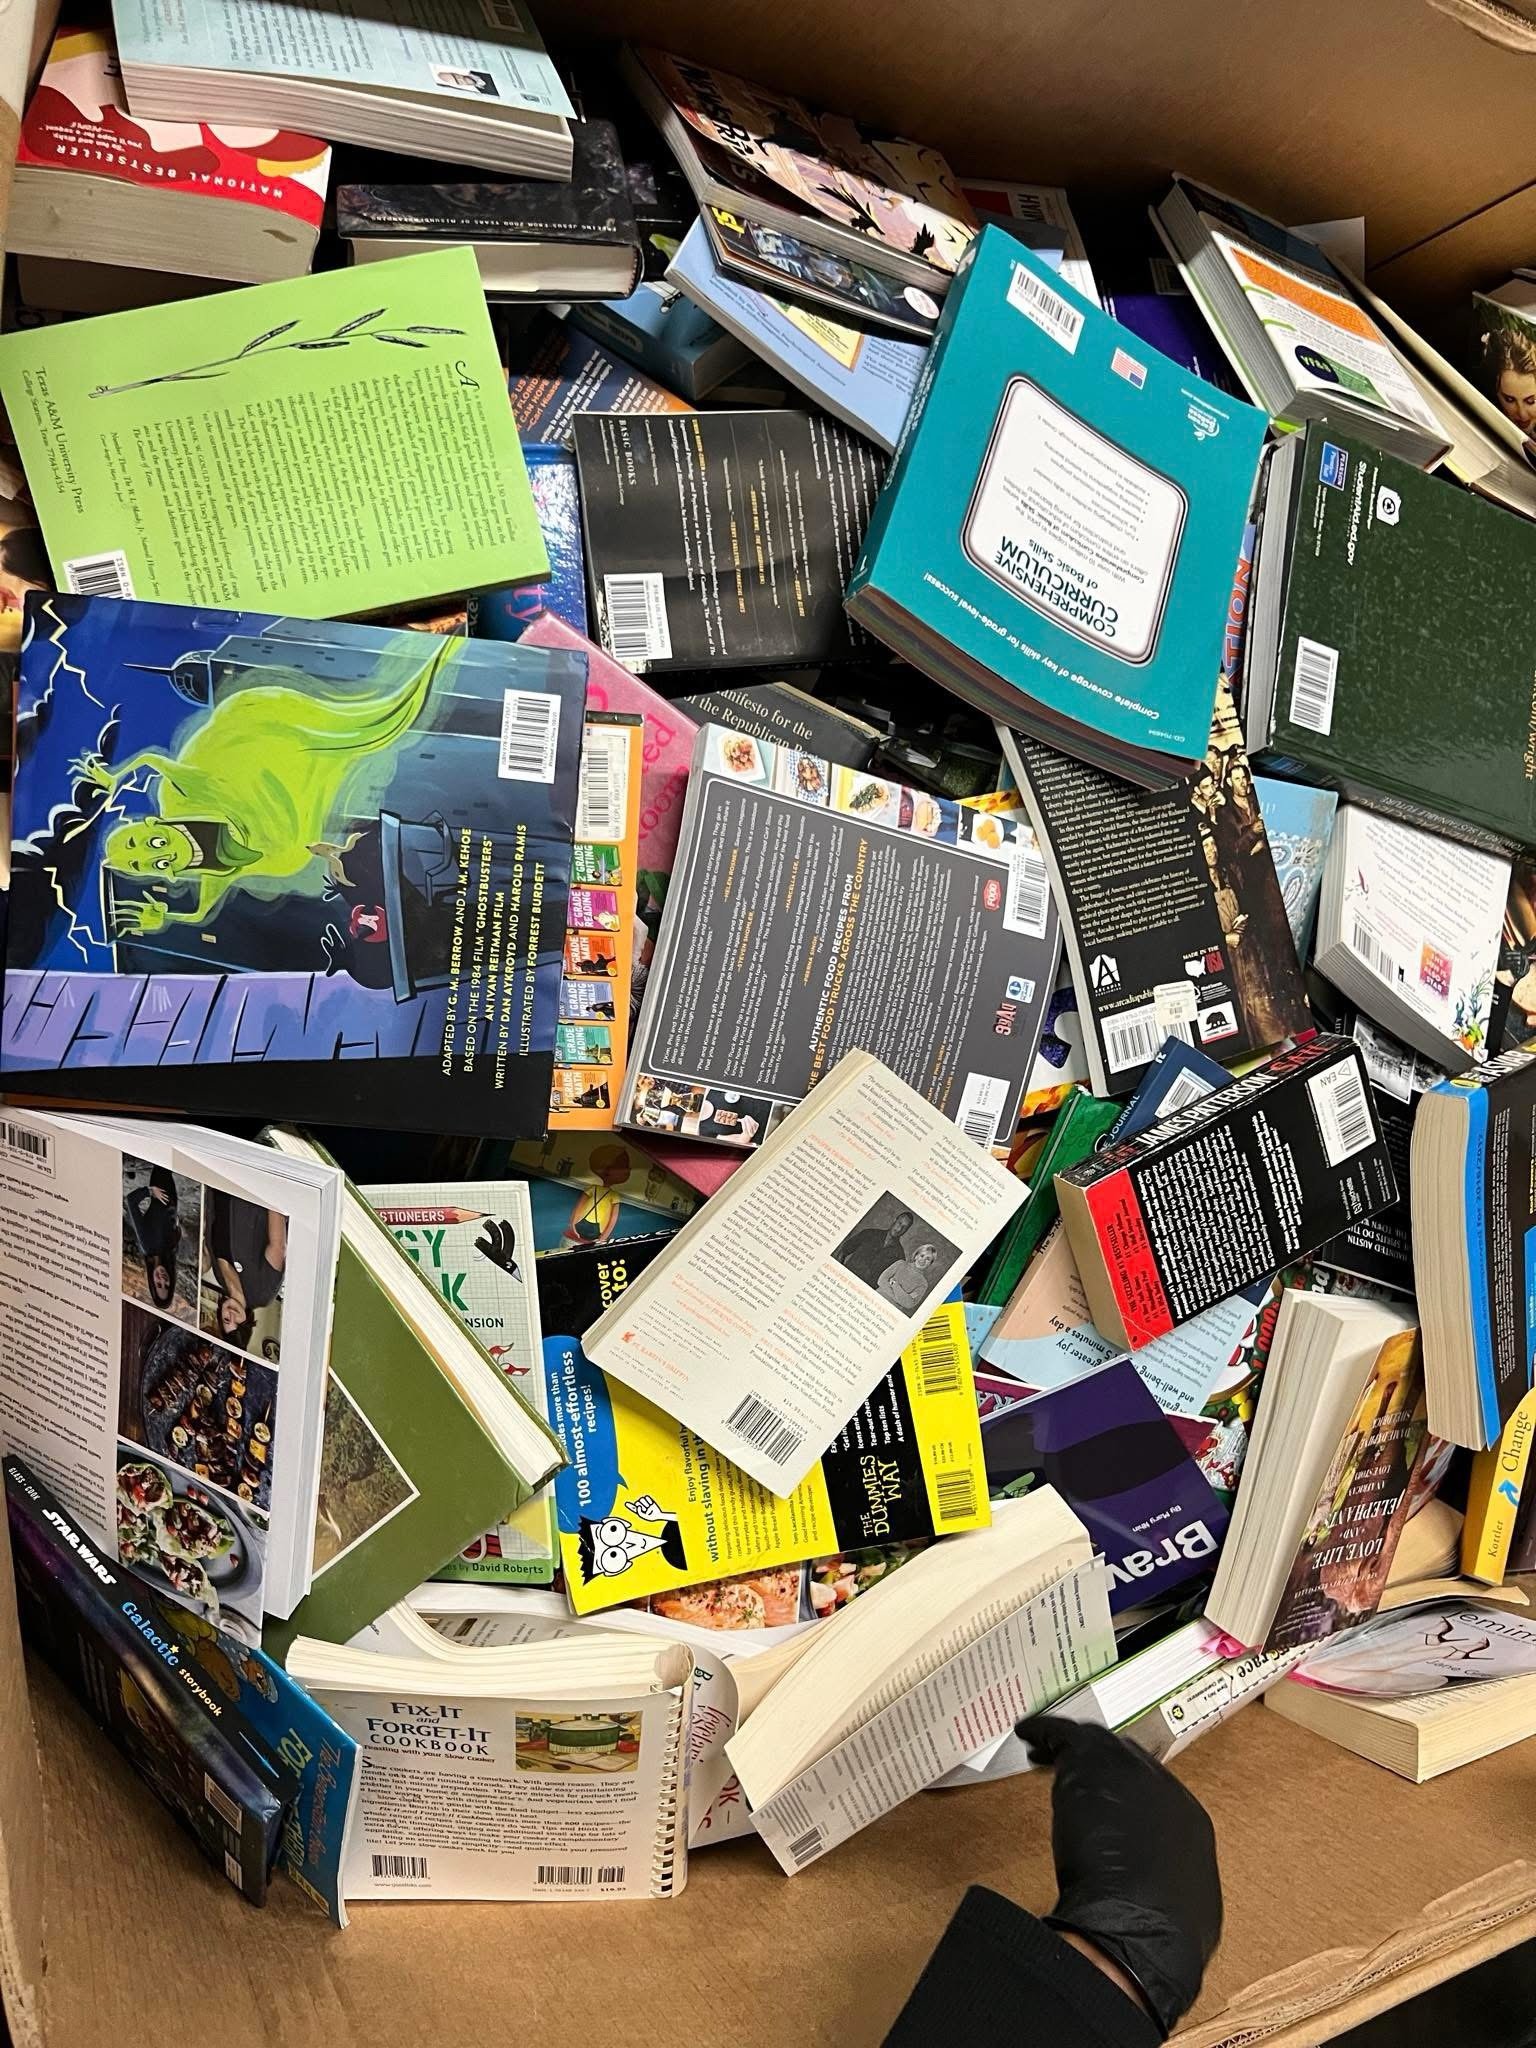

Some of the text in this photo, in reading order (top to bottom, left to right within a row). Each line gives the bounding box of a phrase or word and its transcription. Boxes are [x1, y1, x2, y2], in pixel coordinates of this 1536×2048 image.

[54, 142, 283, 198] NATIONAL BESTSELLER
[518, 377, 550, 424] CAN HOPE
[33, 365, 88, 514] Texas A&M University Press
[617, 418, 636, 486] BASIC BOOKS
[1335, 452, 1346, 486] PEARSON
[1344, 459, 1367, 566] StudentAid.ed.gov
[995, 534, 1121, 625] CURRICULUM
[1025, 537, 1099, 591] of Basic Skills
[990, 550, 1118, 639] COMPREHENSIVE
[922, 570, 1161, 720] Complete coverage of key skills for grade-level success!
[696, 696, 722, 717] the
[718, 706, 793, 754] Republican
[715, 680, 815, 741] anifesto for the
[573, 843, 584, 871] GRADE
[582, 843, 594, 881] WRITING
[571, 890, 582, 917] GRADE
[581, 890, 592, 927] READING
[987, 882, 998, 907] FOOD
[441, 827, 472, 1076] ADAPTED BY G. M. BERROW AND J. M. KEHOE
[472, 935, 484, 962] FILM
[484, 891, 505, 1021] AN IVAN REITMAN FILM
[494, 823, 527, 1089] WRITTEN BY DAN AYKROYD AND HAROLD RAMIS
[518, 862, 546, 1056] ILLUSTRATED BY FORREST BURDETT
[571, 935, 582, 963] GRADE
[579, 936, 590, 959] MATH
[807, 873, 855, 1051] AUTHENTIC FOOD RECIPES FROM
[807, 837, 870, 1091] THE BEST FOOD TRUCKS ACROSS THE COUNTRY
[1181, 950, 1199, 960] MADE
[1207, 944, 1220, 953] THE
[470, 964, 482, 989] 1984
[468, 991, 479, 1013] THE
[568, 982, 580, 1010] GRADE
[575, 981, 587, 1016] WRITING
[466, 1015, 477, 1033] ON
[565, 1026, 576, 1053] GRADE
[462, 1034, 476, 1072] BASED
[574, 1025, 585, 1063] READING
[562, 1070, 573, 1097] GRADE
[572, 1070, 583, 1095] MATH
[1317, 1070, 1339, 1088] EAN
[1109, 1094, 1140, 1140] JOURNAL
[1134, 1062, 1279, 1153] JAMES PATTERSON
[381, 1210, 445, 1222] STIONEERS
[1344, 1233, 1373, 1250] AUSTIN
[1361, 1227, 1401, 1248] SPIRITS DO
[608, 1258, 629, 1292] to:
[1046, 1313, 1195, 1407] and well-being 5 minutes a day
[1053, 1336, 1102, 1370] greater joy
[549, 1371, 561, 1394] than
[552, 1396, 564, 1421] more
[580, 1384, 598, 1433] recipes!
[559, 1350, 591, 1506] 100 almost-effortless
[1499, 1408, 1535, 1474] Change
[7, 1465, 26, 1485] GLASS
[680, 1433, 698, 1502] Enjoy flavorful
[876, 1455, 903, 1502] WAY
[1353, 1463, 1392, 1480] LOVE STORY
[695, 1448, 720, 1561] without slaving in
[858, 1453, 891, 1536] DUMMIES
[1346, 1479, 1386, 1496] AN AFRICAN
[859, 1511, 874, 1536] THE
[1131, 1503, 1182, 1533] By Mary Nhin
[1342, 1526, 1361, 1537] AND
[40, 1504, 118, 1589] STAR WARS
[1097, 1516, 1219, 1595] Brav
[1310, 1537, 1383, 1569] LOVE, LIFE,
[1486, 1518, 1505, 1558] Kottler
[471, 1562, 544, 1574] David Roberts
[119, 1598, 182, 1668] Galactic
[176, 1665, 224, 1718] storybook
[416, 1715, 439, 1724] and
[369, 1732, 490, 1756] COOKBOOK
